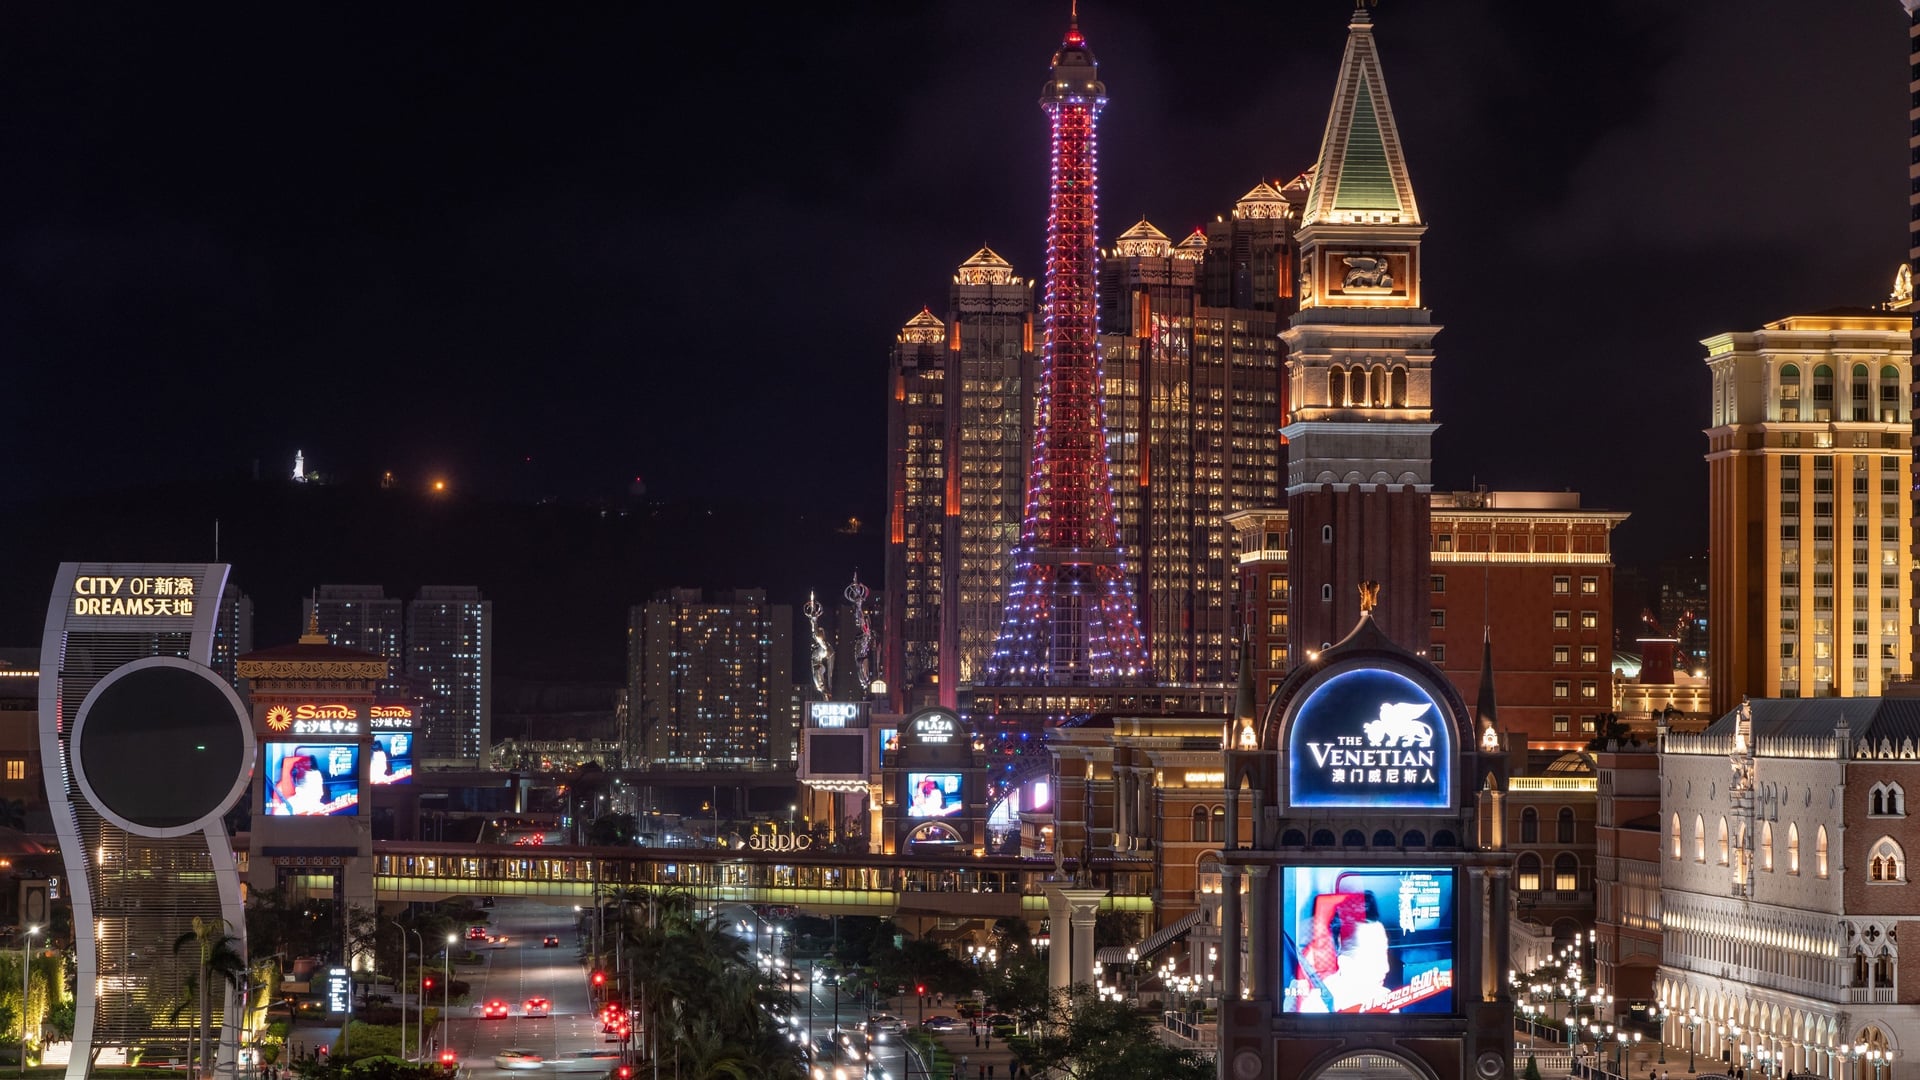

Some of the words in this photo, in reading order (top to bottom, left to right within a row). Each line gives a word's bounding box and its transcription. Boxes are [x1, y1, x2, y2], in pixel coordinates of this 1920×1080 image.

[75, 576, 124, 595] CITY
[130, 578, 154, 595] OF
[154, 576, 194, 595] 新濠
[75, 598, 154, 615] DREAMS
[154, 598, 193, 616] 天地
[295, 704, 357, 719] Sands
[370, 706, 412, 718] Sands
[917, 721, 953, 731] PLAZA
[1338, 736, 1362, 746] THE
[1306, 742, 1435, 768] VENETIAN
[1332, 769, 1435, 783] 澳门威尼斯人
[748, 834, 811, 852] STUDIO
